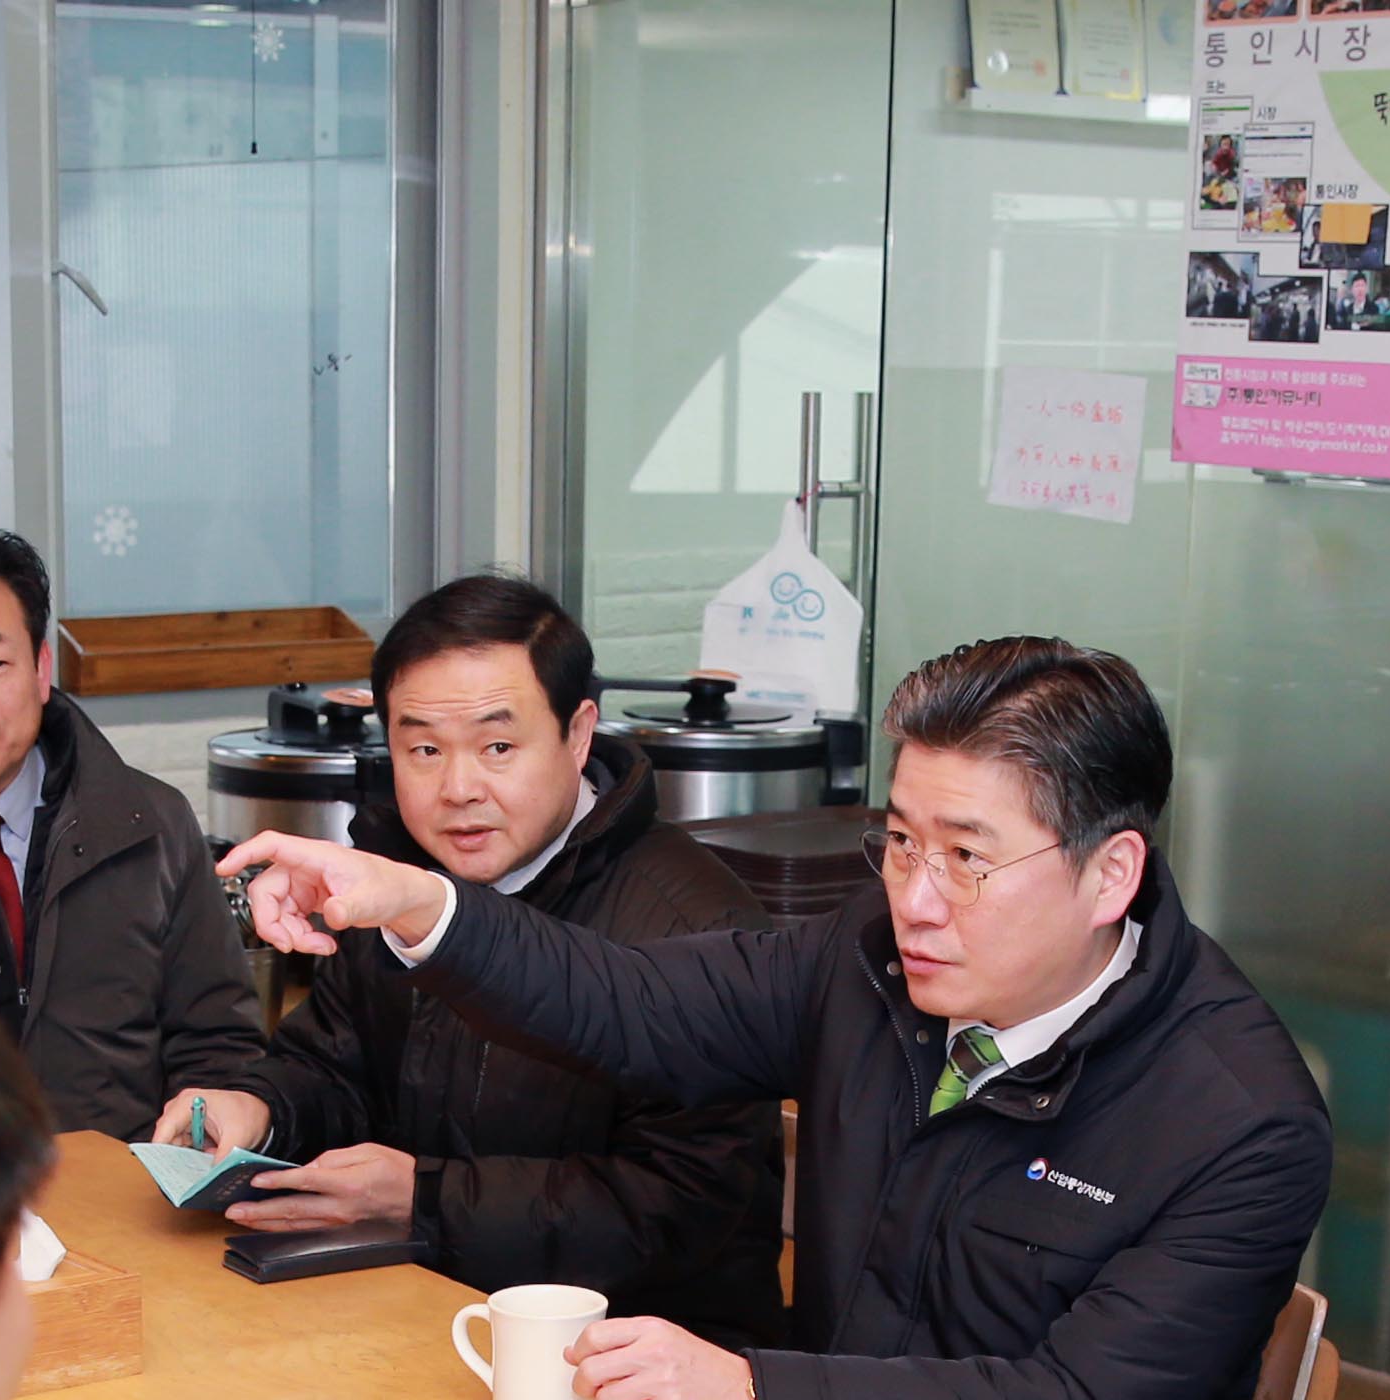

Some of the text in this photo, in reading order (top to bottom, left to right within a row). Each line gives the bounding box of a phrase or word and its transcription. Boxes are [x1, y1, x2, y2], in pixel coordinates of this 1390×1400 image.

[1257, 107, 1277, 120] 시장
[1315, 184, 1358, 199] 통인시장
[1047, 1169, 1116, 1205] 산업통상자원부
